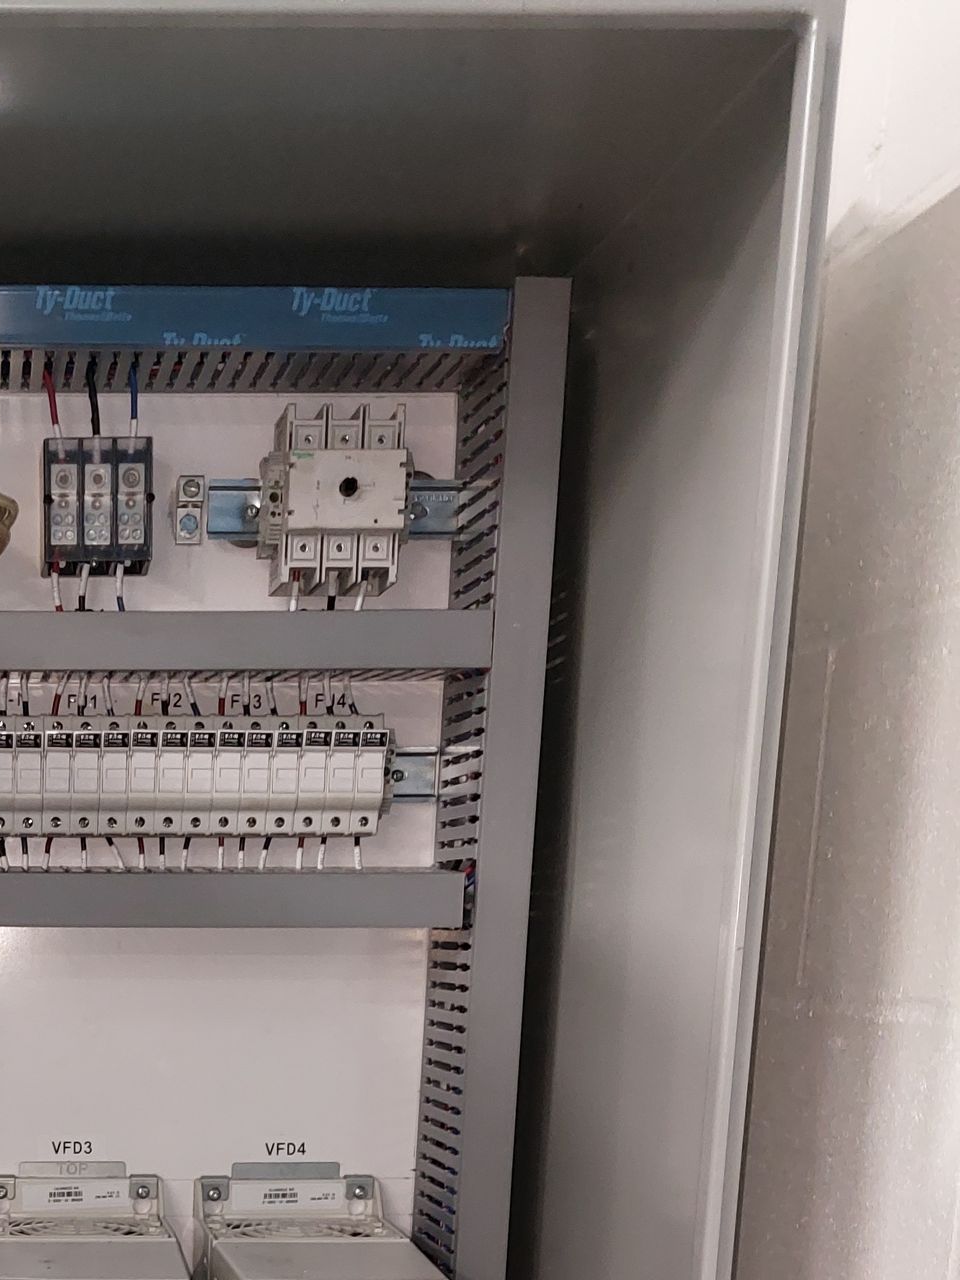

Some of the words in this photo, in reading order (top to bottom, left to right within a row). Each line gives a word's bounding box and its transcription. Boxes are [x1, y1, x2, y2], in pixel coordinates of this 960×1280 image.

[34, 285, 115, 315] Ty-Duct
[291, 287, 373, 316] Ty-Duct
[230, 693, 262, 710] F3
[51, 1140, 93, 1155] VFD3
[265, 1142, 306, 1157] VFD4
[56, 1162, 88, 1176] TOP
